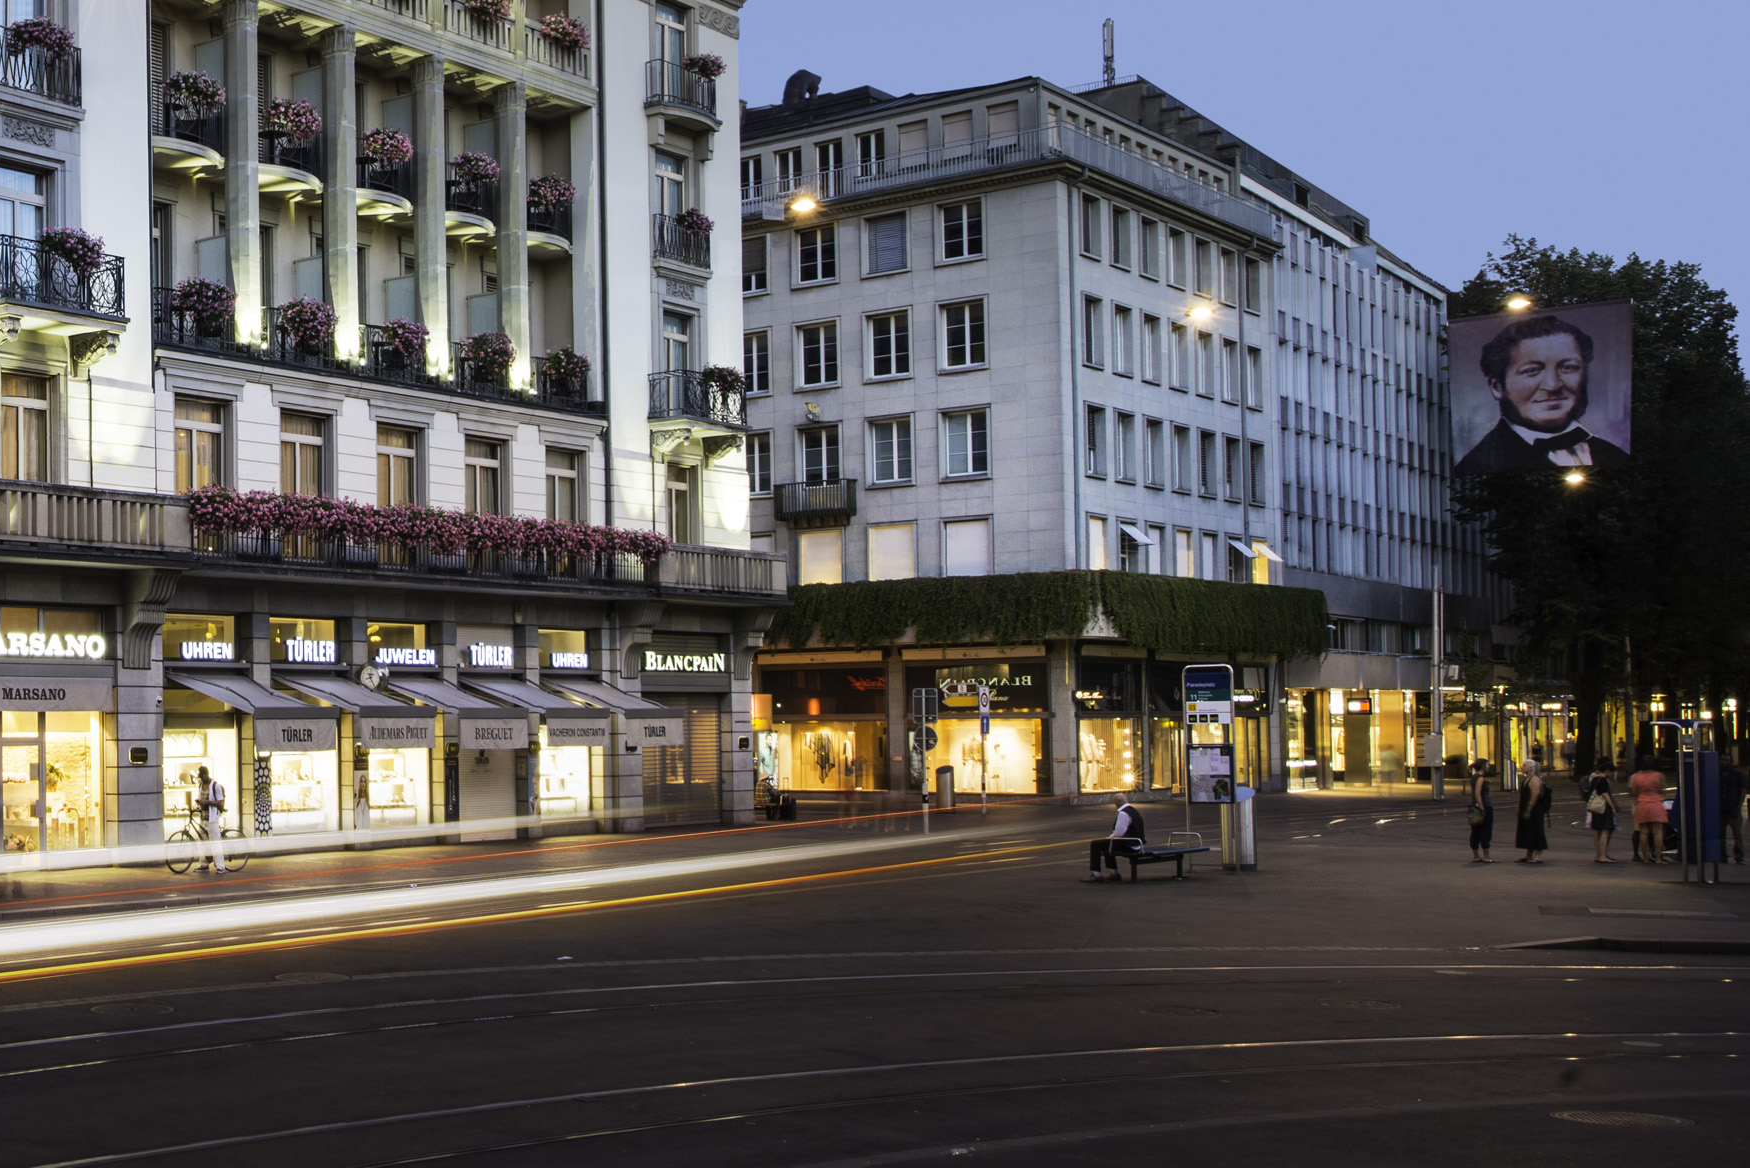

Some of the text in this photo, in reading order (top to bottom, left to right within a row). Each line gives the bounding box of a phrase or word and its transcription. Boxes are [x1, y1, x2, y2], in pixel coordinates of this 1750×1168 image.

[180, 641, 233, 660] UHREN
[285, 635, 335, 663] TÜRLER
[374, 647, 436, 665] JUWELEN
[470, 642, 512, 667] TÜRLER
[552, 653, 588, 668] UHREN
[644, 650, 725, 673] BLANCPAIN
[2, 687, 66, 701] MARSANO
[281, 727, 313, 743] TÜRLER
[406, 725, 428, 739] PIGUET
[475, 728, 514, 740] BREGUET
[549, 728, 606, 737] VACHERON CONSTANTIN
[644, 725, 667, 738] TÜRLER
